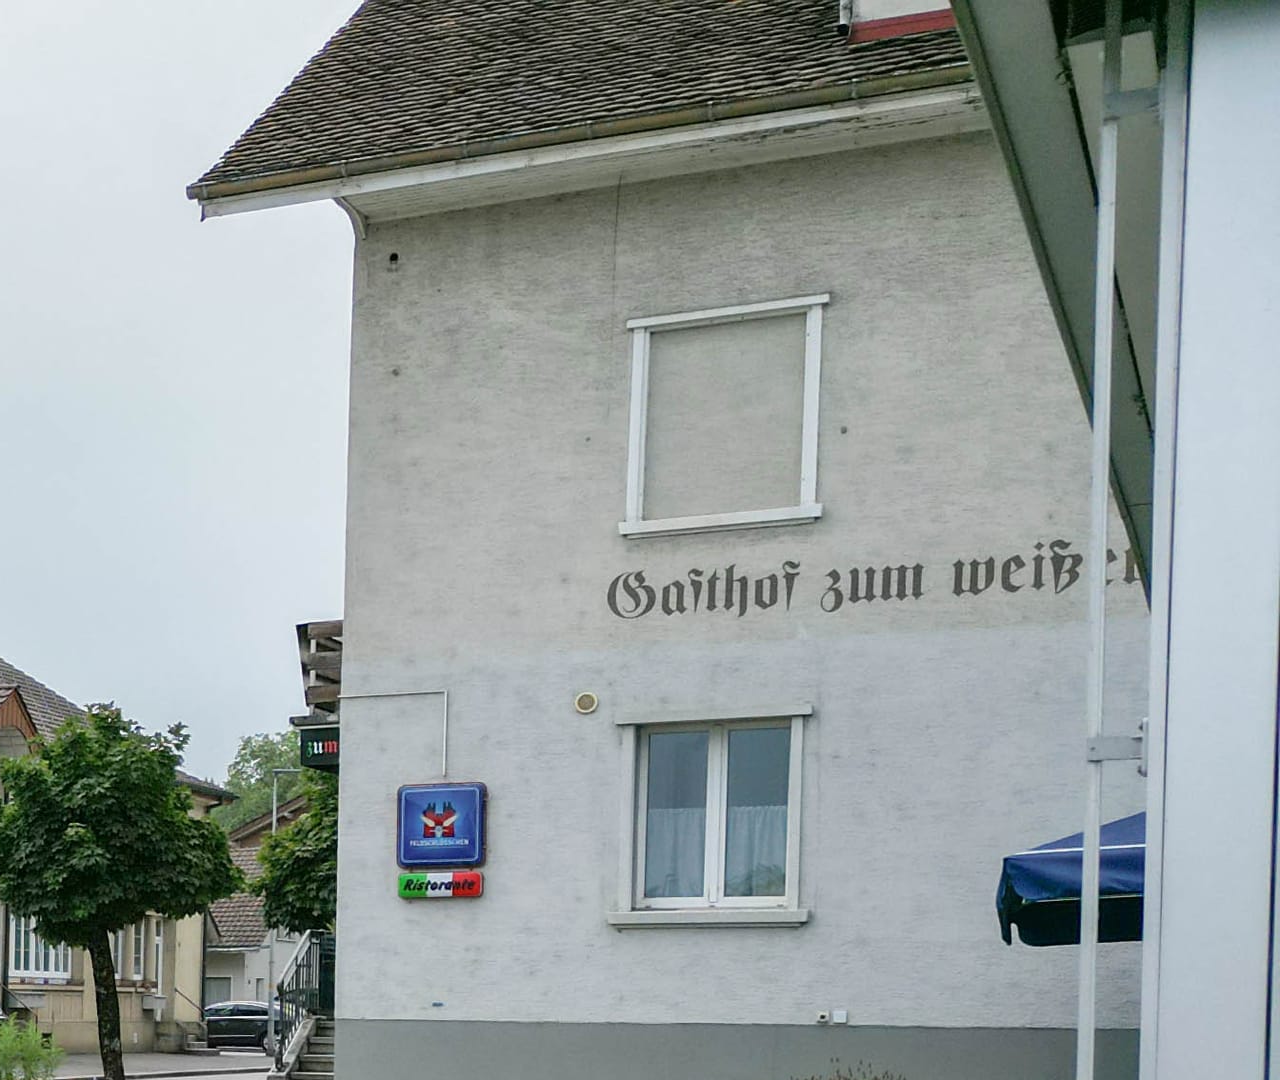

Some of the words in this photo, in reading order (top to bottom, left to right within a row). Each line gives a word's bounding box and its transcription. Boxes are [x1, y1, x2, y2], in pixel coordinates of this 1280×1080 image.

[606, 560, 801, 620] Gasthof
[820, 562, 925, 613] zum
[305, 740, 338, 758] zum
[402, 878, 477, 892] Ristorante
